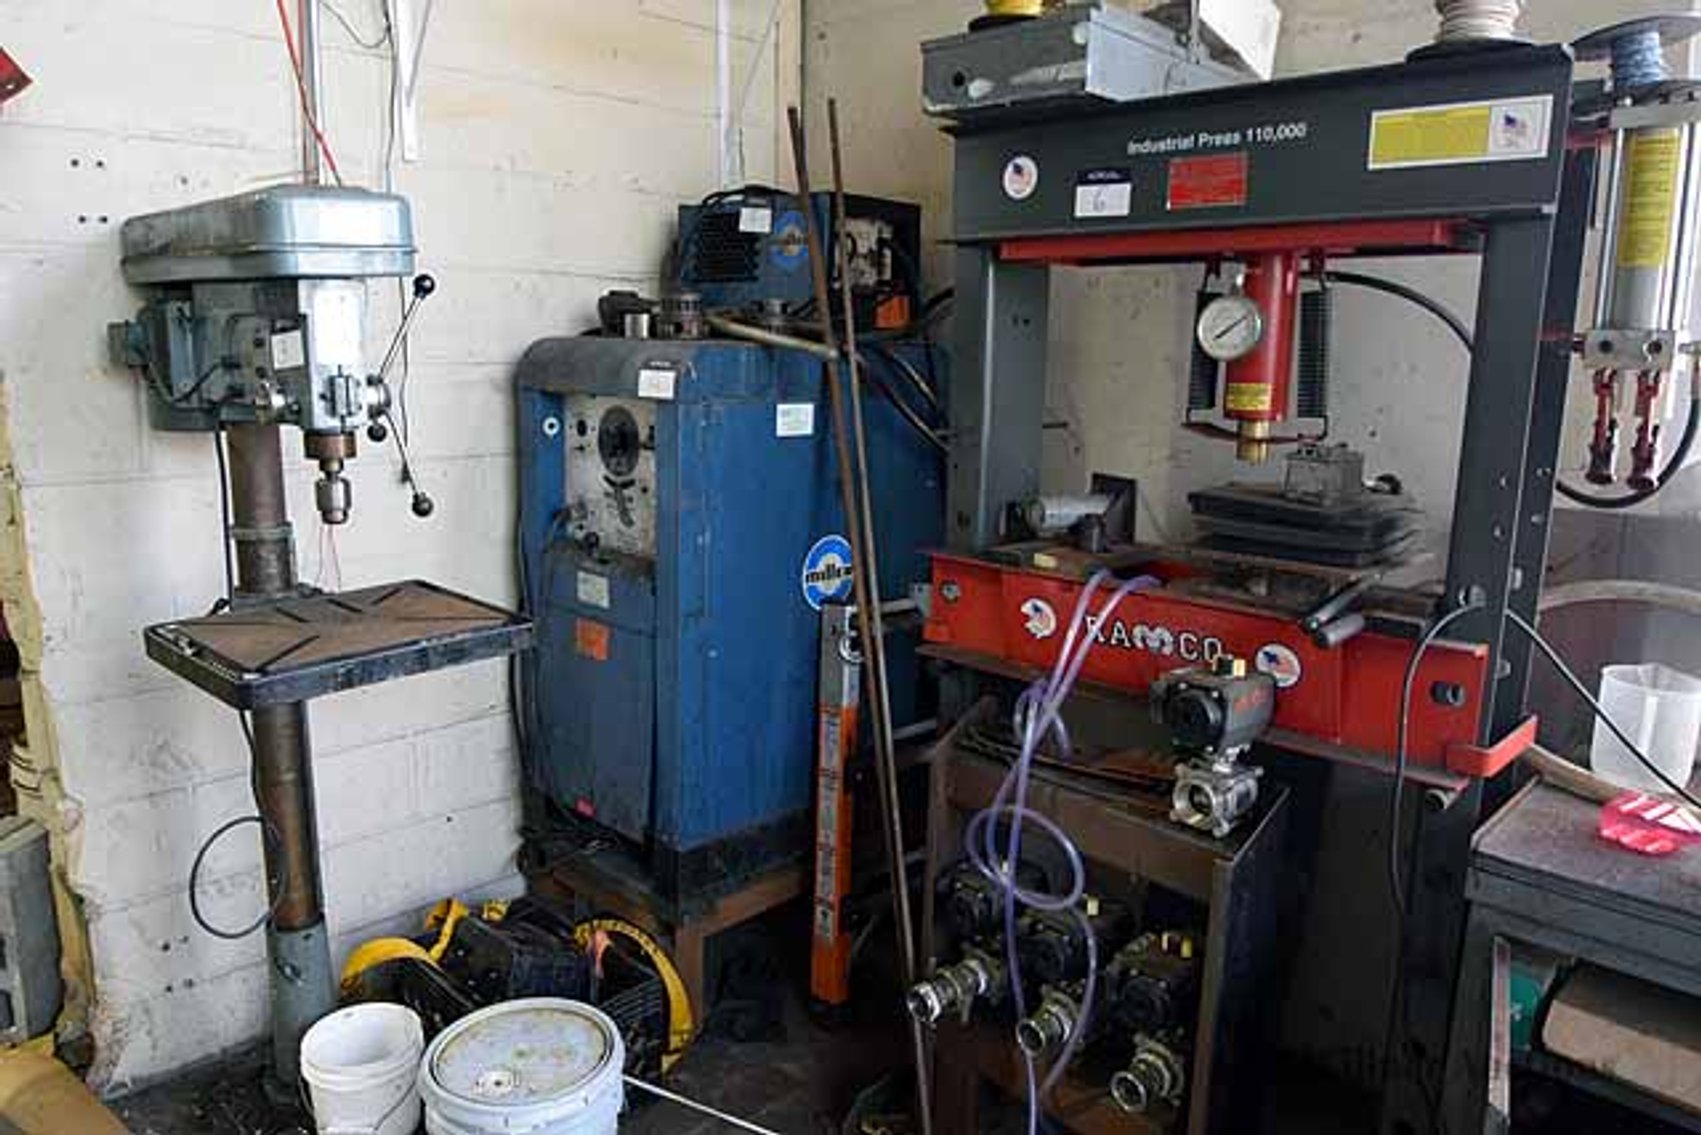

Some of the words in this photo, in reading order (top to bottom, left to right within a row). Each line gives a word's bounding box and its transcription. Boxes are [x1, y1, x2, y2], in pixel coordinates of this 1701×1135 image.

[1127, 134, 1195, 155] Industrial
[1199, 131, 1241, 147] Press
[1246, 122, 1307, 142] 110,000
